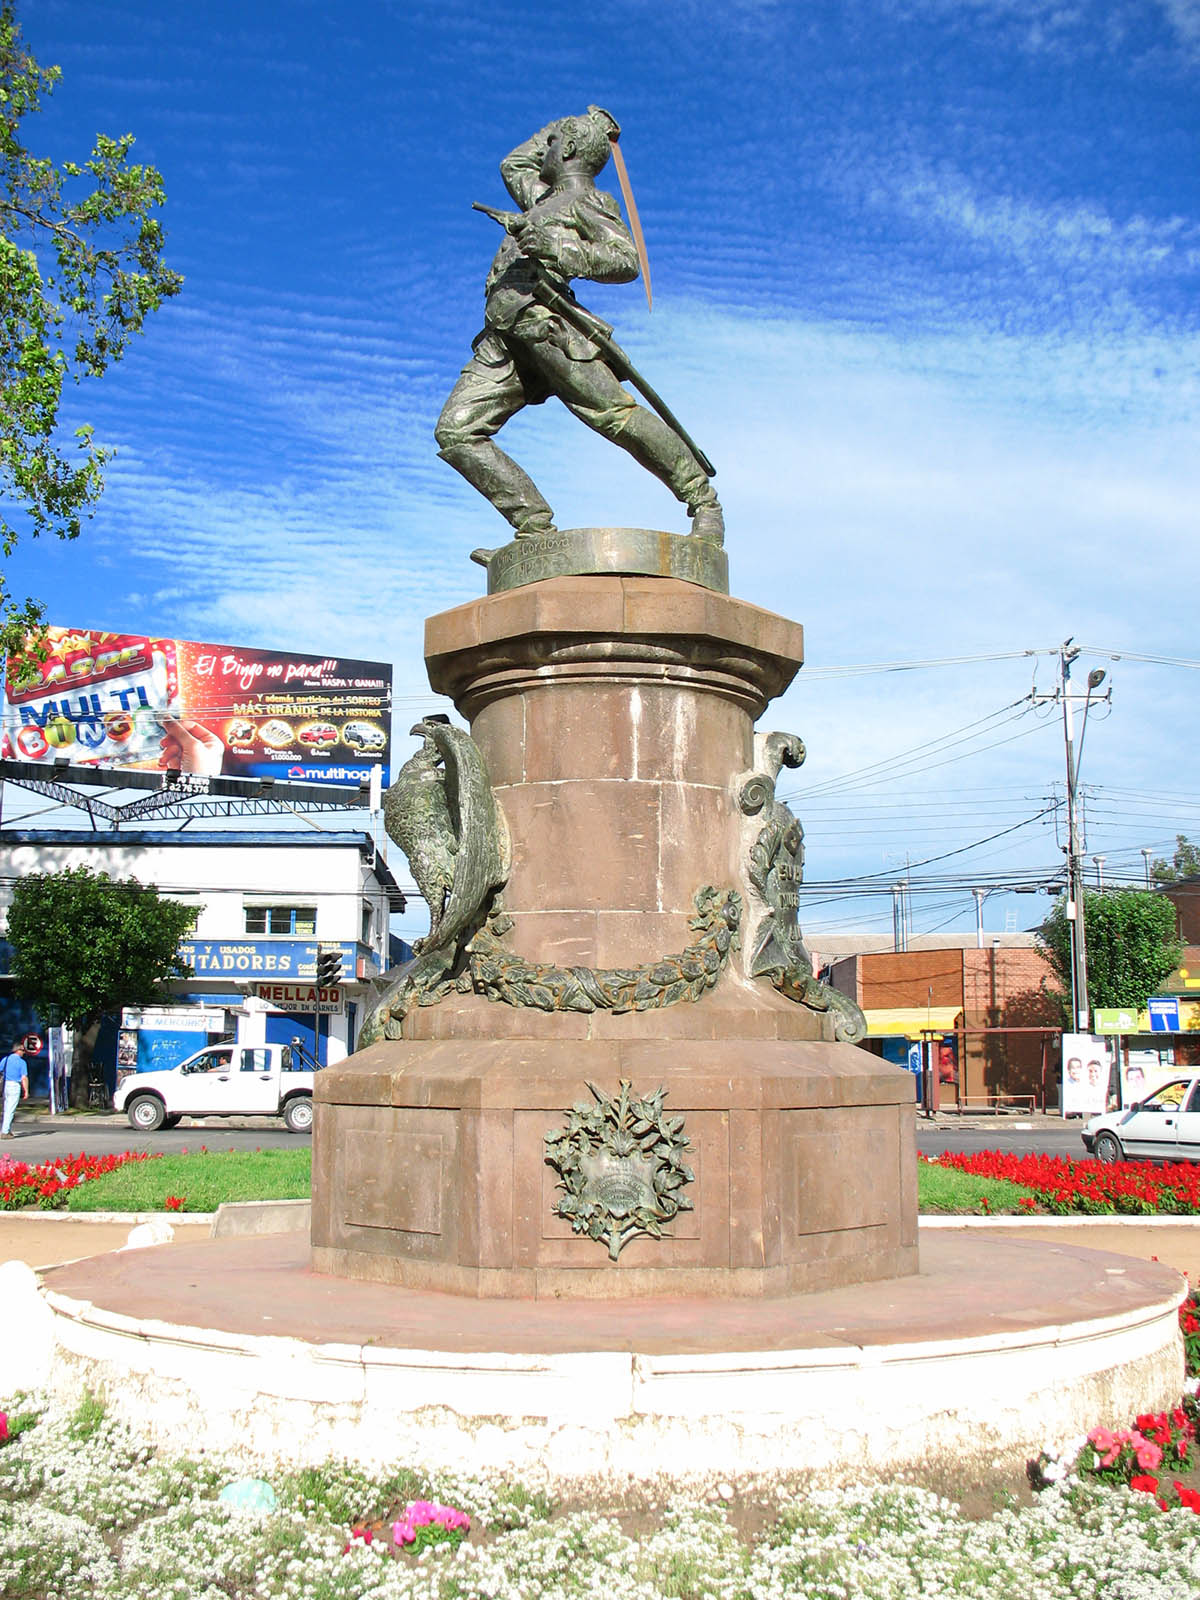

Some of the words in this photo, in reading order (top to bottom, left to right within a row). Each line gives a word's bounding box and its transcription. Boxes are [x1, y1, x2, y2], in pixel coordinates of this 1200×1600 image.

[12, 643, 147, 697] RASPE
[194, 655, 216, 676] El
[220, 655, 262, 690] Bingo
[266, 665, 284, 678] no
[321, 678, 347, 688] RASPA
[347, 679, 354, 688] Y
[18, 685, 150, 729] MULTI
[256, 693, 264, 703] Y
[346, 695, 382, 707] SORTEO
[233, 700, 262, 715] MÁS
[266, 702, 318, 717] GRANDE
[320, 707, 333, 716] DE
[333, 707, 345, 716] LA
[346, 708, 383, 718] HISTORIA
[219, 945, 257, 954] USADOS
[259, 986, 340, 1002] MELLADO
[312, 1004, 339, 1012] CARNES
